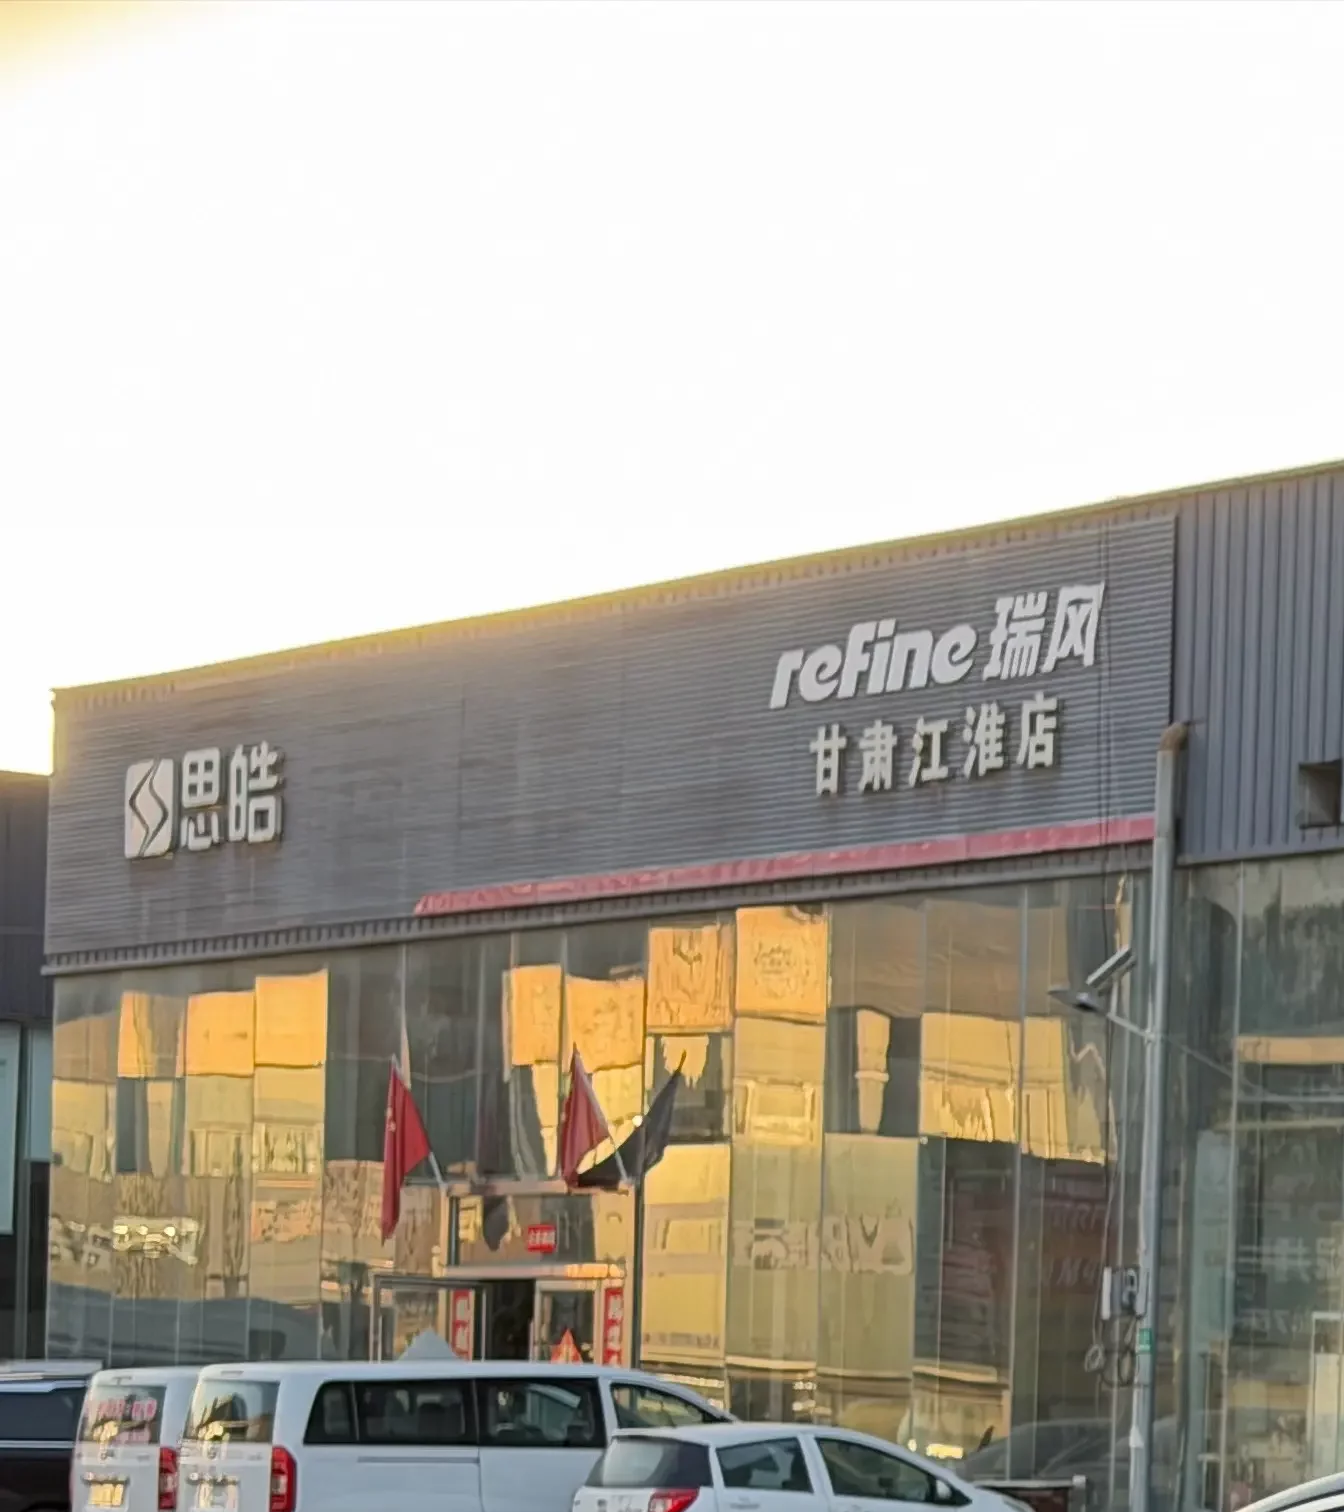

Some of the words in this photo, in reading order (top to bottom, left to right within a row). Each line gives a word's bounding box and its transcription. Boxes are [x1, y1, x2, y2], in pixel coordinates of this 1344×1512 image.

[769, 618, 978, 709] refine
[982, 580, 1106, 682] 瑞风
[180, 740, 280, 851] 思皓
[809, 691, 1059, 797] 甘肃江淮店
